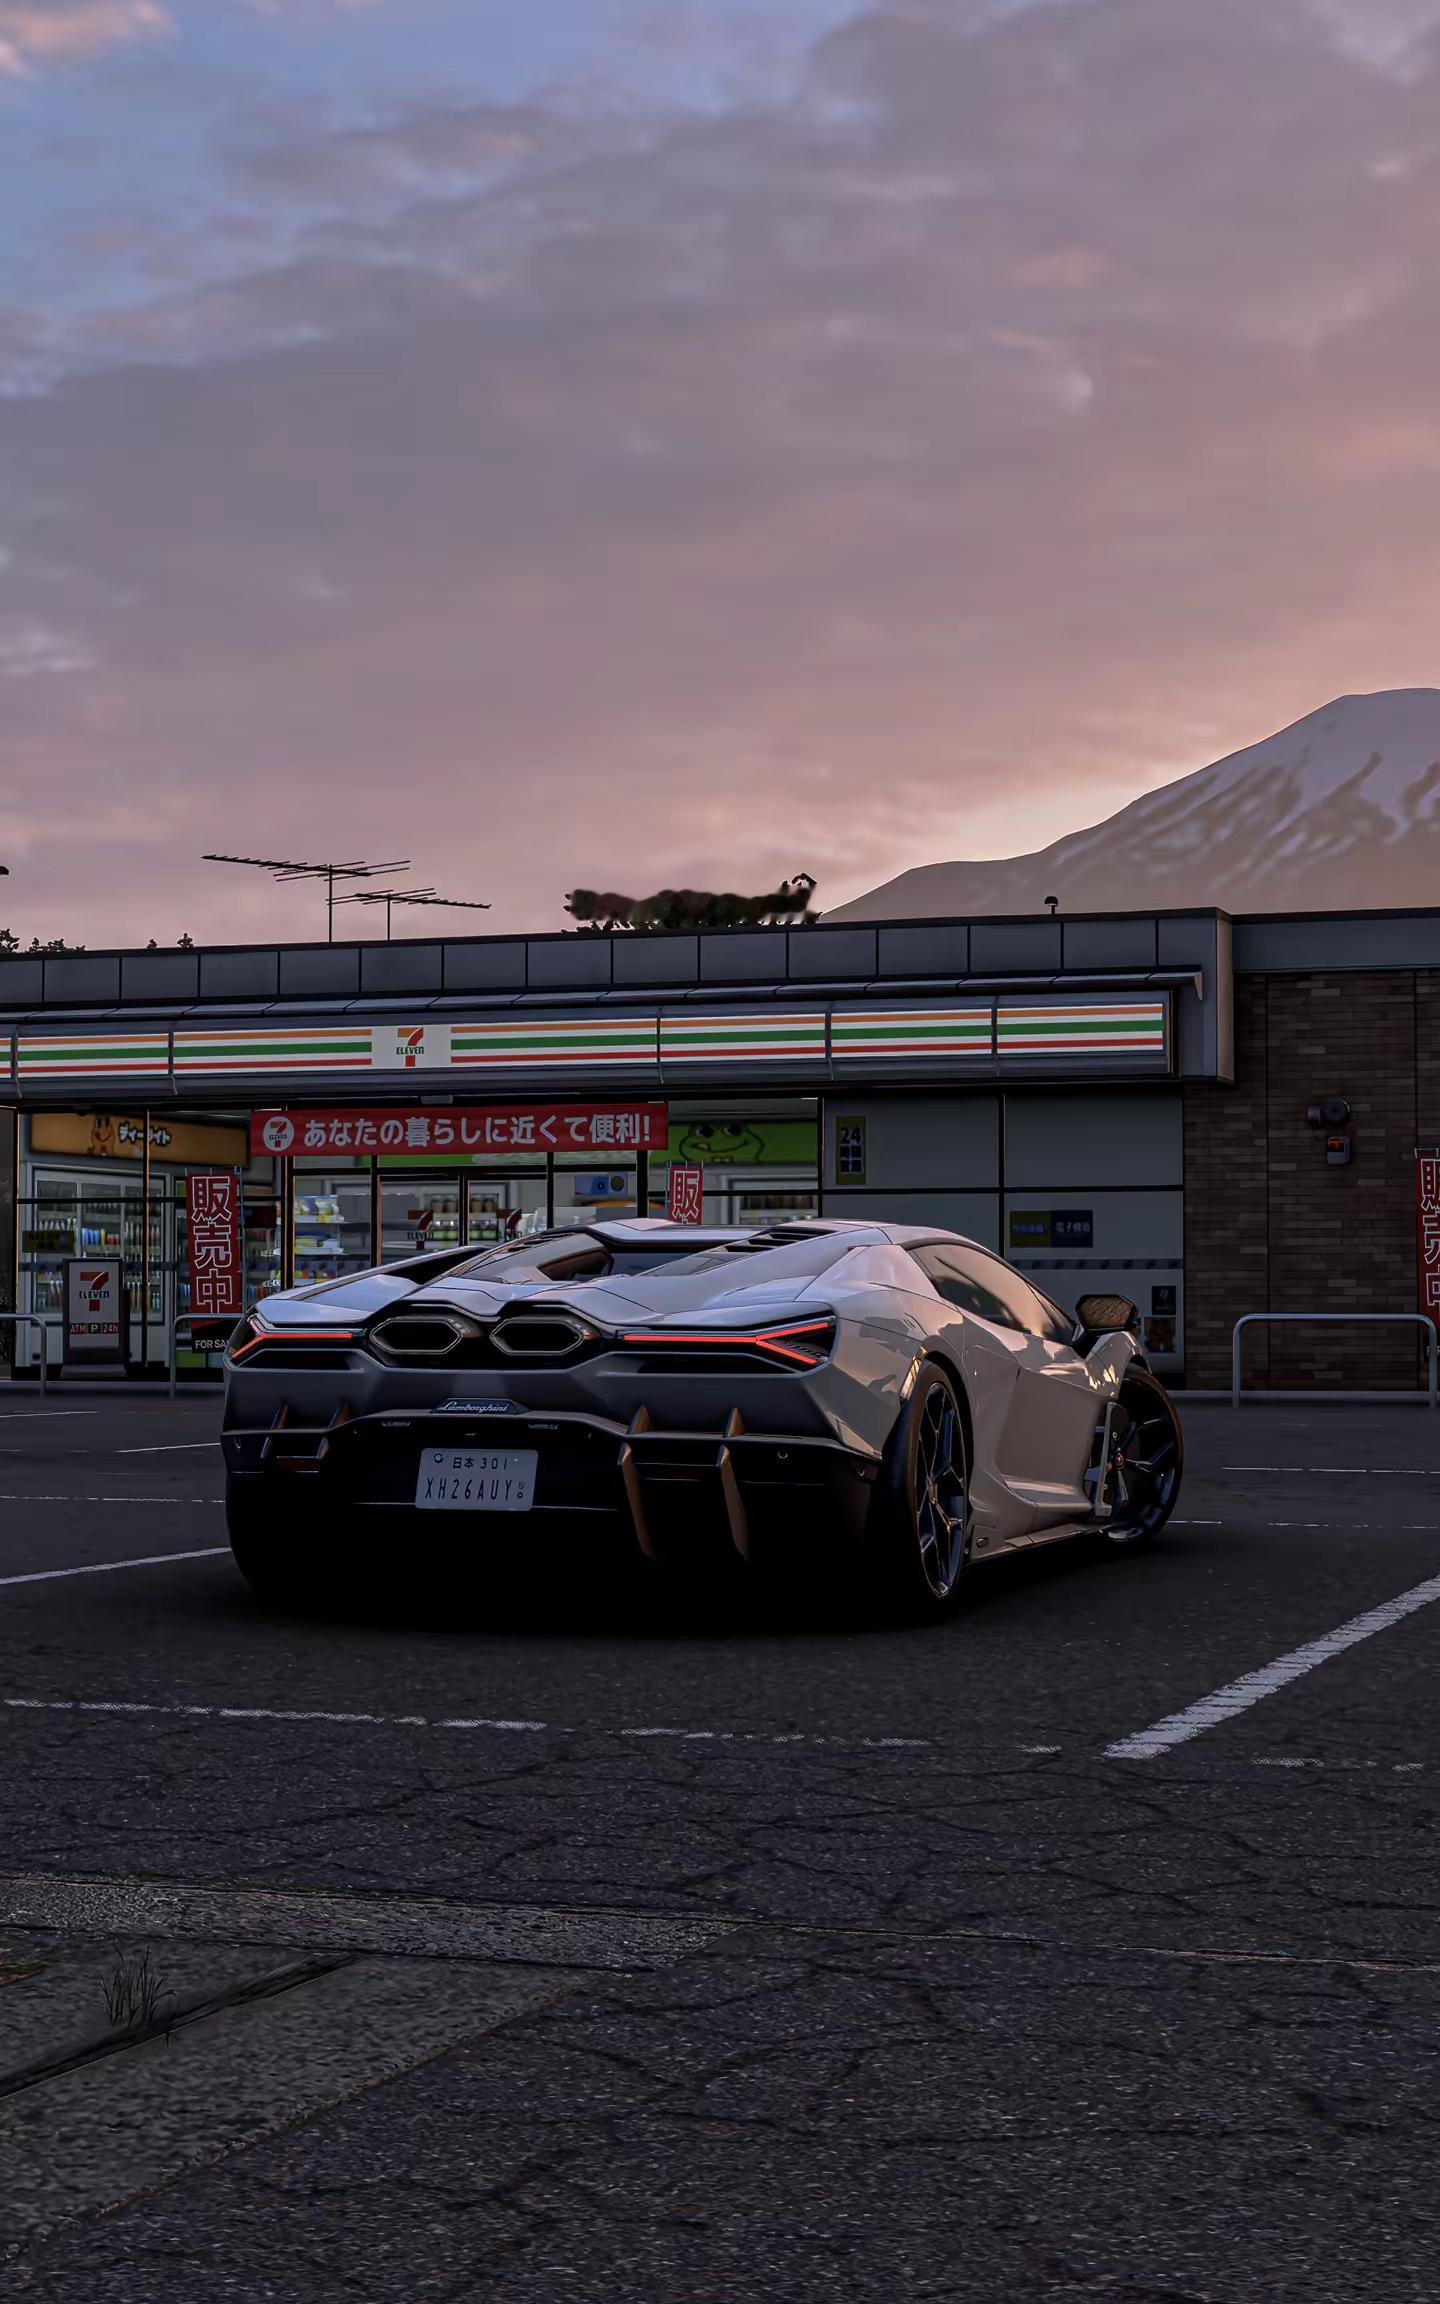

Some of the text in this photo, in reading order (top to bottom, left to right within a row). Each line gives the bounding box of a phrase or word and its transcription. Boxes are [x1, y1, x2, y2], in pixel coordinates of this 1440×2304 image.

[303, 1113, 650, 1148] あなたの暮らしに近くて便利!
[672, 1170, 700, 1224] 販
[191, 1176, 232, 1314] 販売中
[70, 1323, 118, 1333] ATM P 24h
[195, 1339, 228, 1350] FOR SA
[439, 1401, 510, 1413] Lamborghini
[453, 1457, 507, 1469] 日本 301
[425, 1478, 512, 1500] XH26AUY
